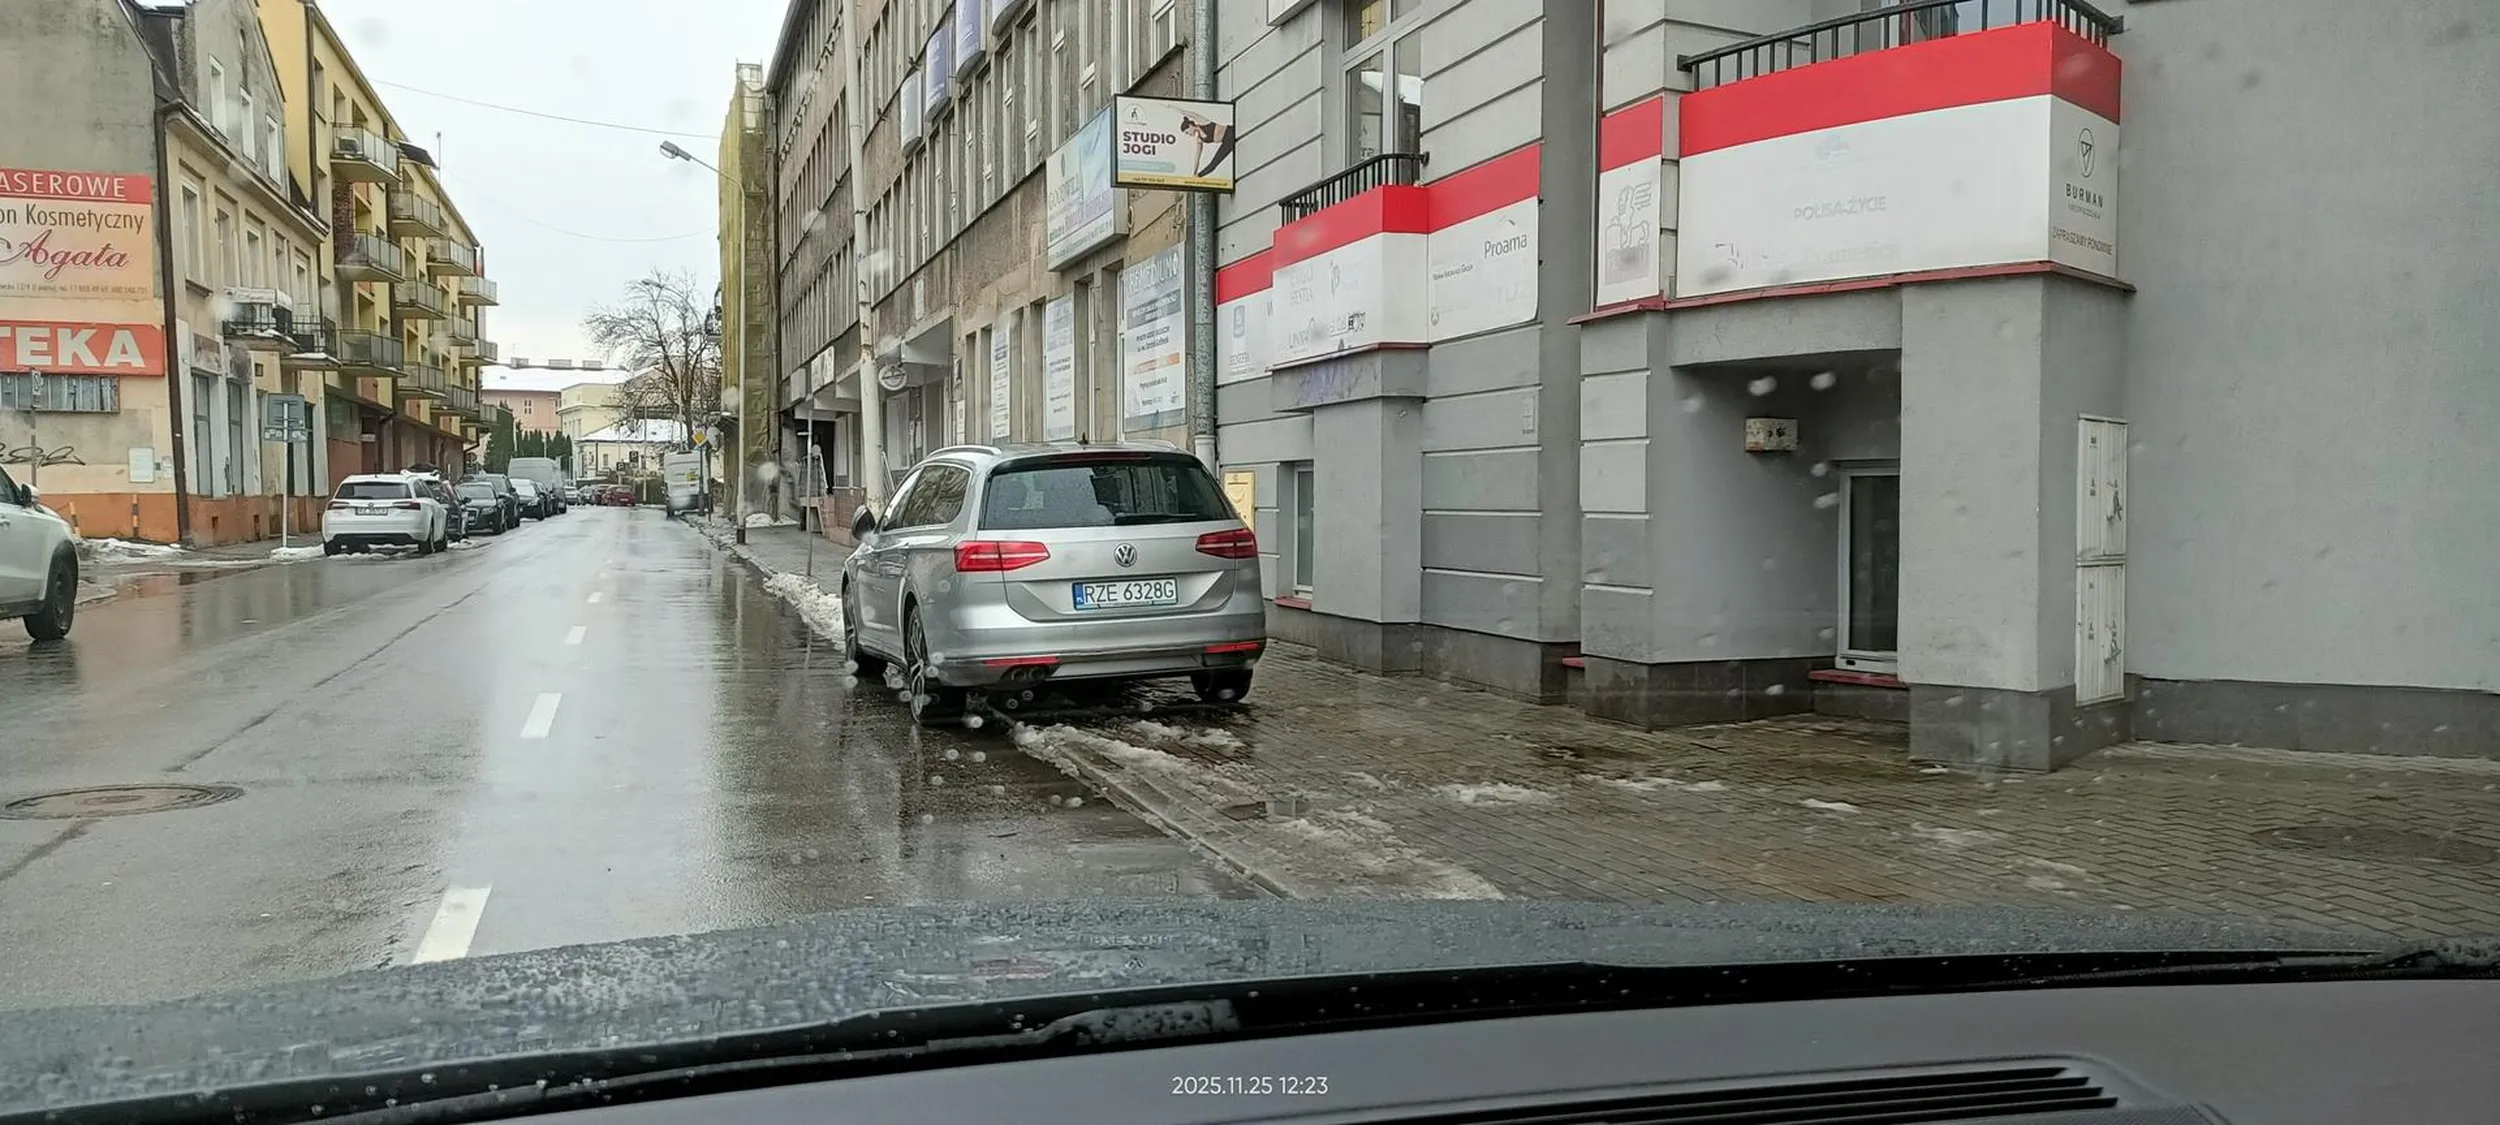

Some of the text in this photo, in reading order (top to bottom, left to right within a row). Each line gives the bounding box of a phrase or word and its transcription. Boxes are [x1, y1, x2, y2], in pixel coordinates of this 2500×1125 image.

[1123, 131, 1176, 145] STUDIO
[1123, 143, 1156, 156] JOGI
[2066, 183, 2104, 208] BURMAN
[26, 203, 144, 235] Kosmetyczny
[18, 229, 129, 280] Agata
[1484, 233, 1528, 260] Proama
[0, 326, 146, 368] EKA
[1084, 584, 1118, 603] RZE
[1123, 581, 1174, 601] 6328G
